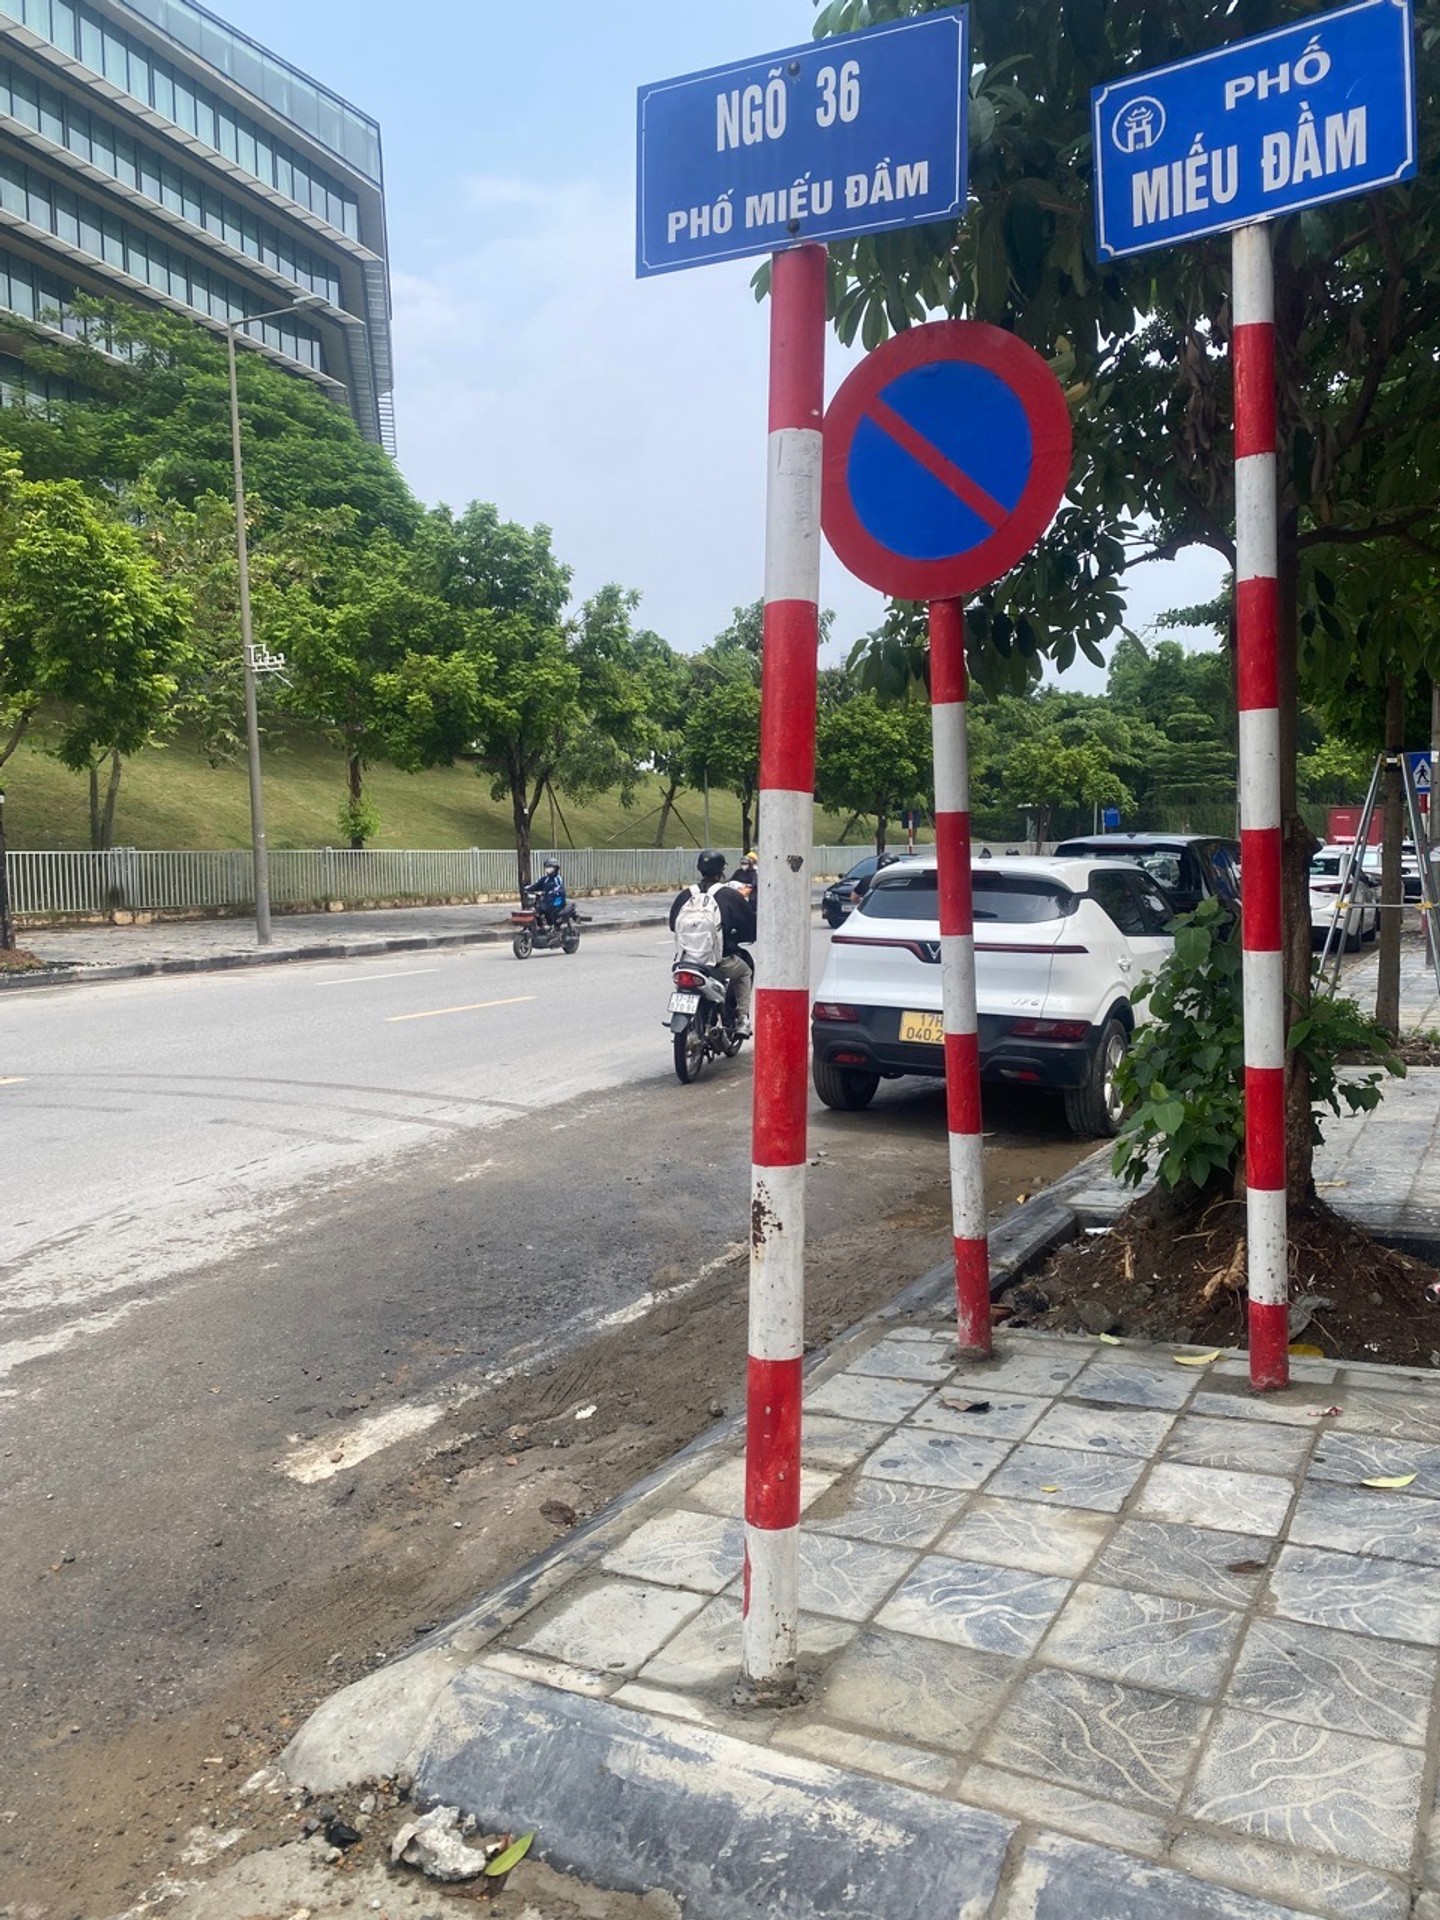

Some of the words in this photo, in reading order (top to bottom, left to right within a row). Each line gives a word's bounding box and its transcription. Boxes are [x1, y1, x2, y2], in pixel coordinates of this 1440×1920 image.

[716, 66, 787, 152] NGÕ
[816, 60, 861, 128] 36
[1225, 33, 1332, 111] PHỐ
[667, 188, 735, 244] PHỐ
[745, 171, 834, 229] MIẾU
[844, 157, 930, 209] ĐẦM
[1132, 132, 1239, 228] MIẾU
[1261, 100, 1368, 193] ĐẦM
[906, 1027, 943, 1042] 040.2
